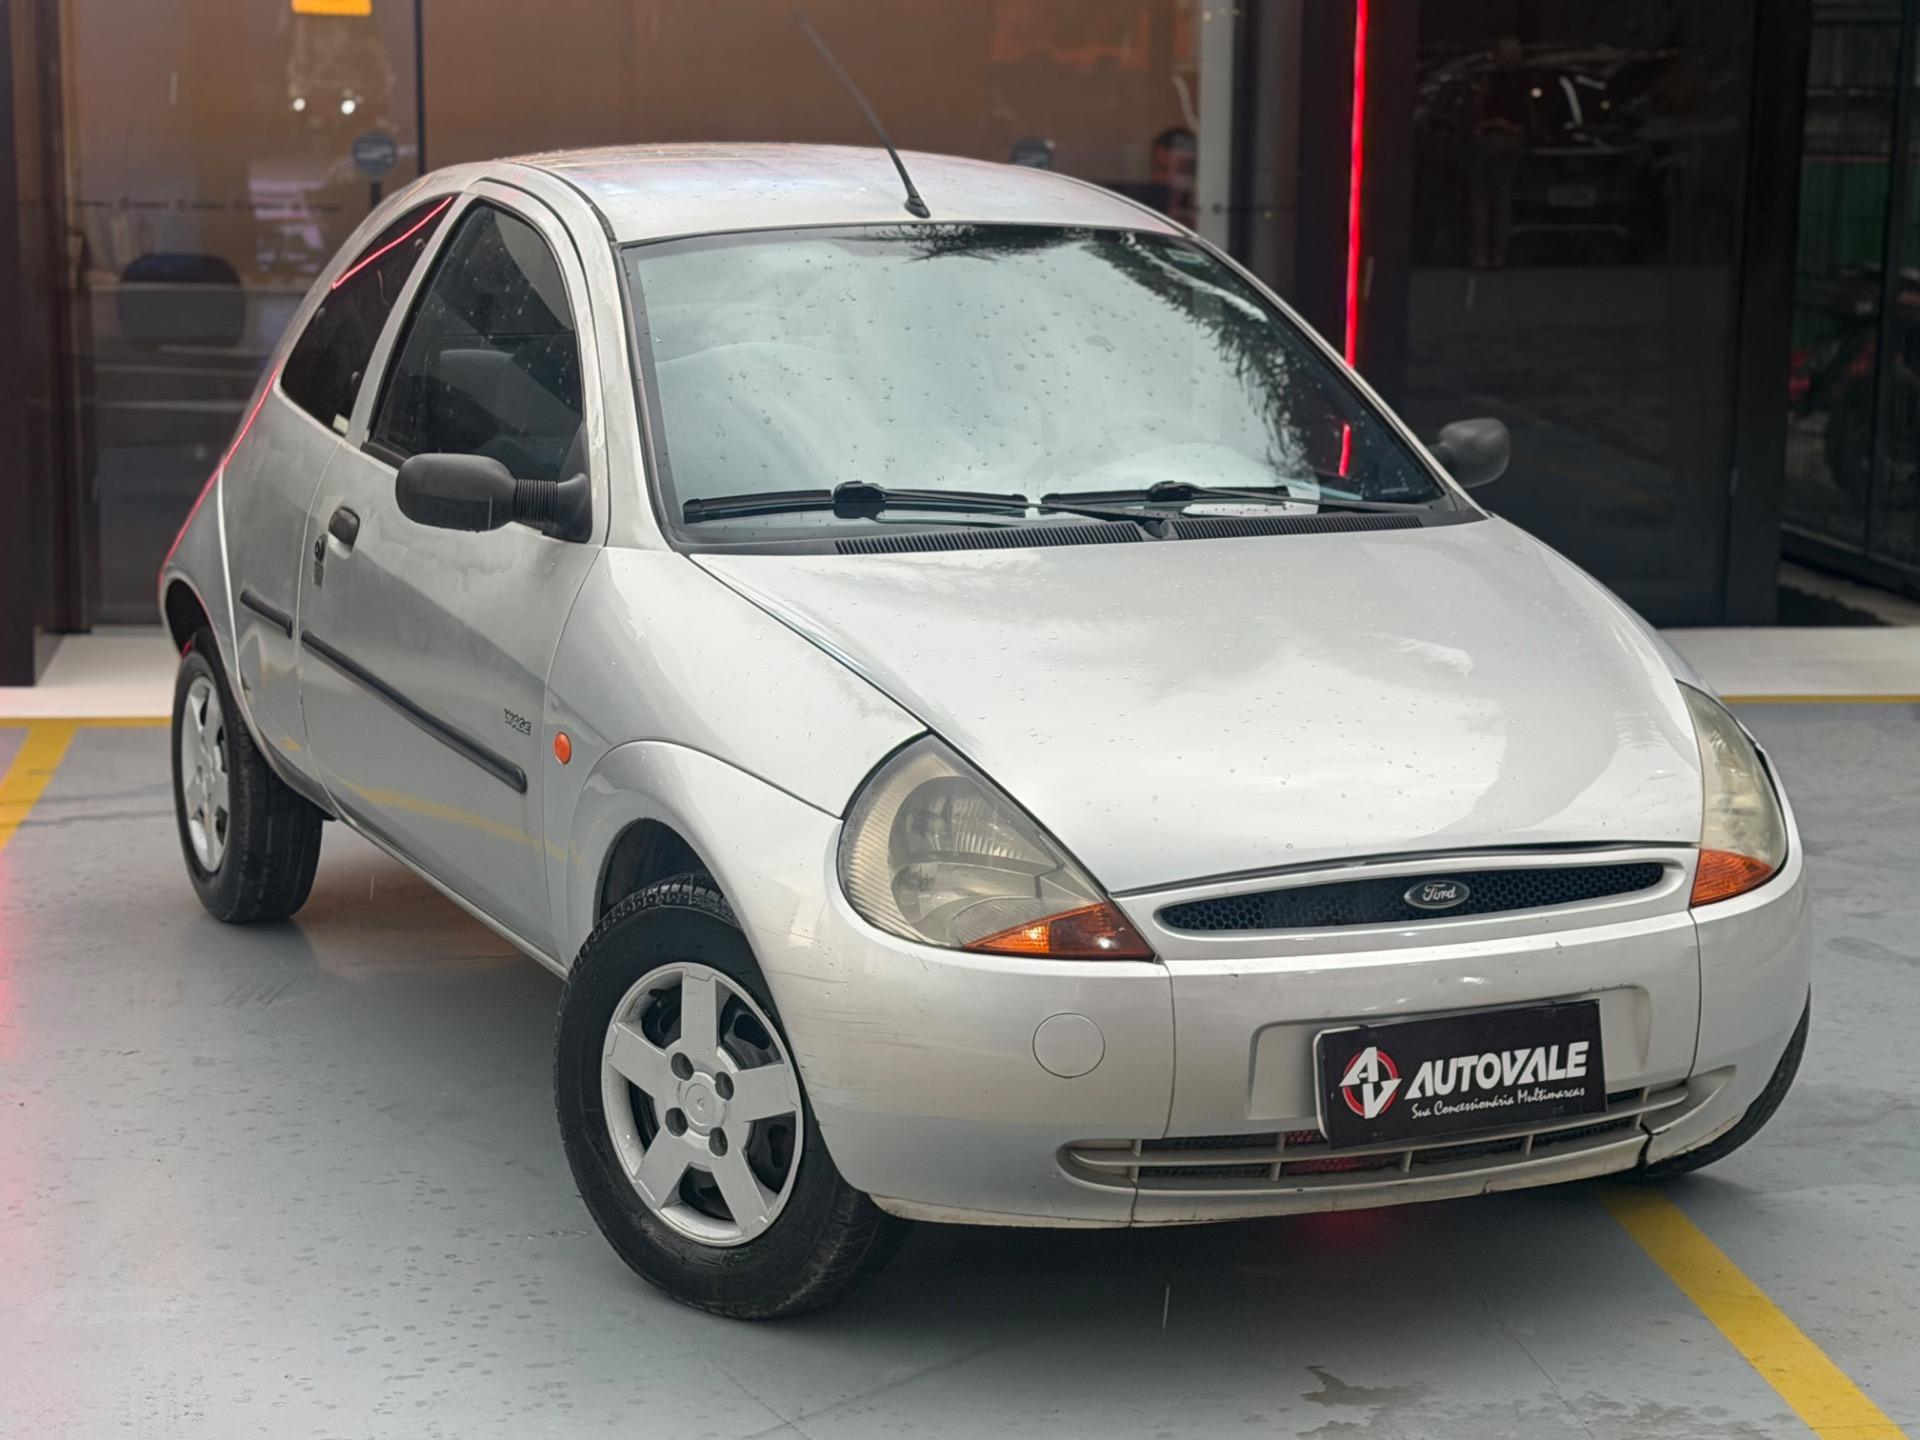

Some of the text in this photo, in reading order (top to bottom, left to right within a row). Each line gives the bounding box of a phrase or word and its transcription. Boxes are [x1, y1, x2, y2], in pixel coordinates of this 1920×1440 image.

[1422, 883, 1456, 902] Ford
[1403, 1041, 1590, 1100] AUTOVALE
[1411, 1087, 1586, 1119] Sua Concessionária Multimarcas
